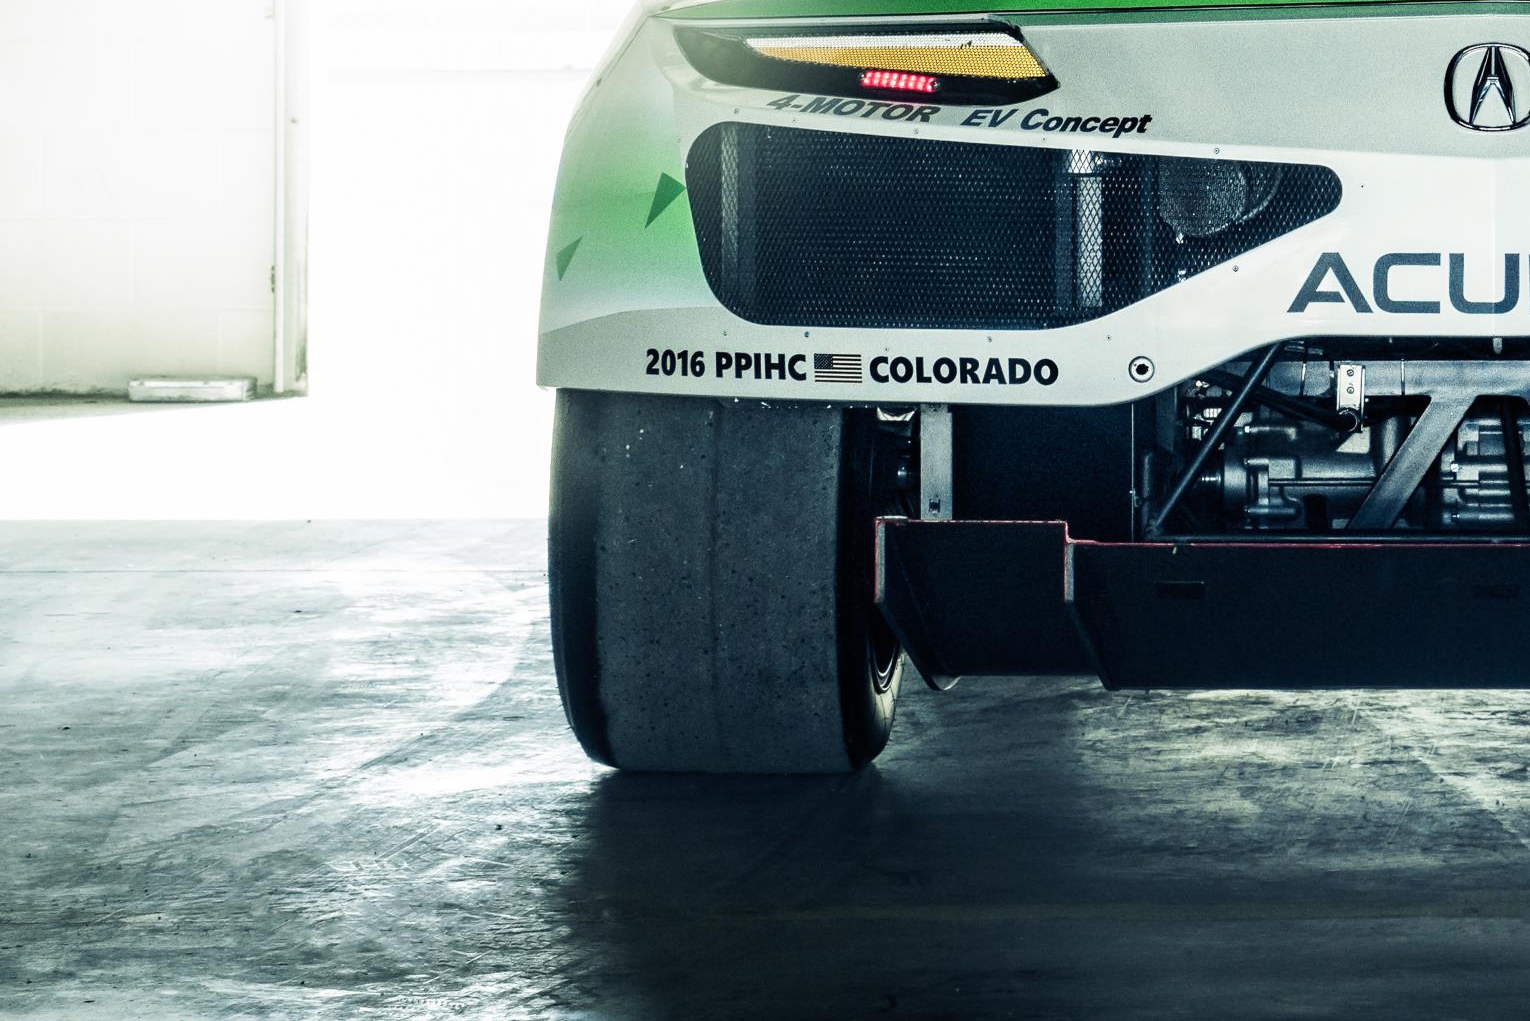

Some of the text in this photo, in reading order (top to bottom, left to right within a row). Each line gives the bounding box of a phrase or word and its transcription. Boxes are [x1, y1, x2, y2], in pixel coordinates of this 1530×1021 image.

[767, 94, 1153, 138] 4-MOTOR EV Concept
[646, 349, 1059, 386] 2016 PPIHC COLORADO
